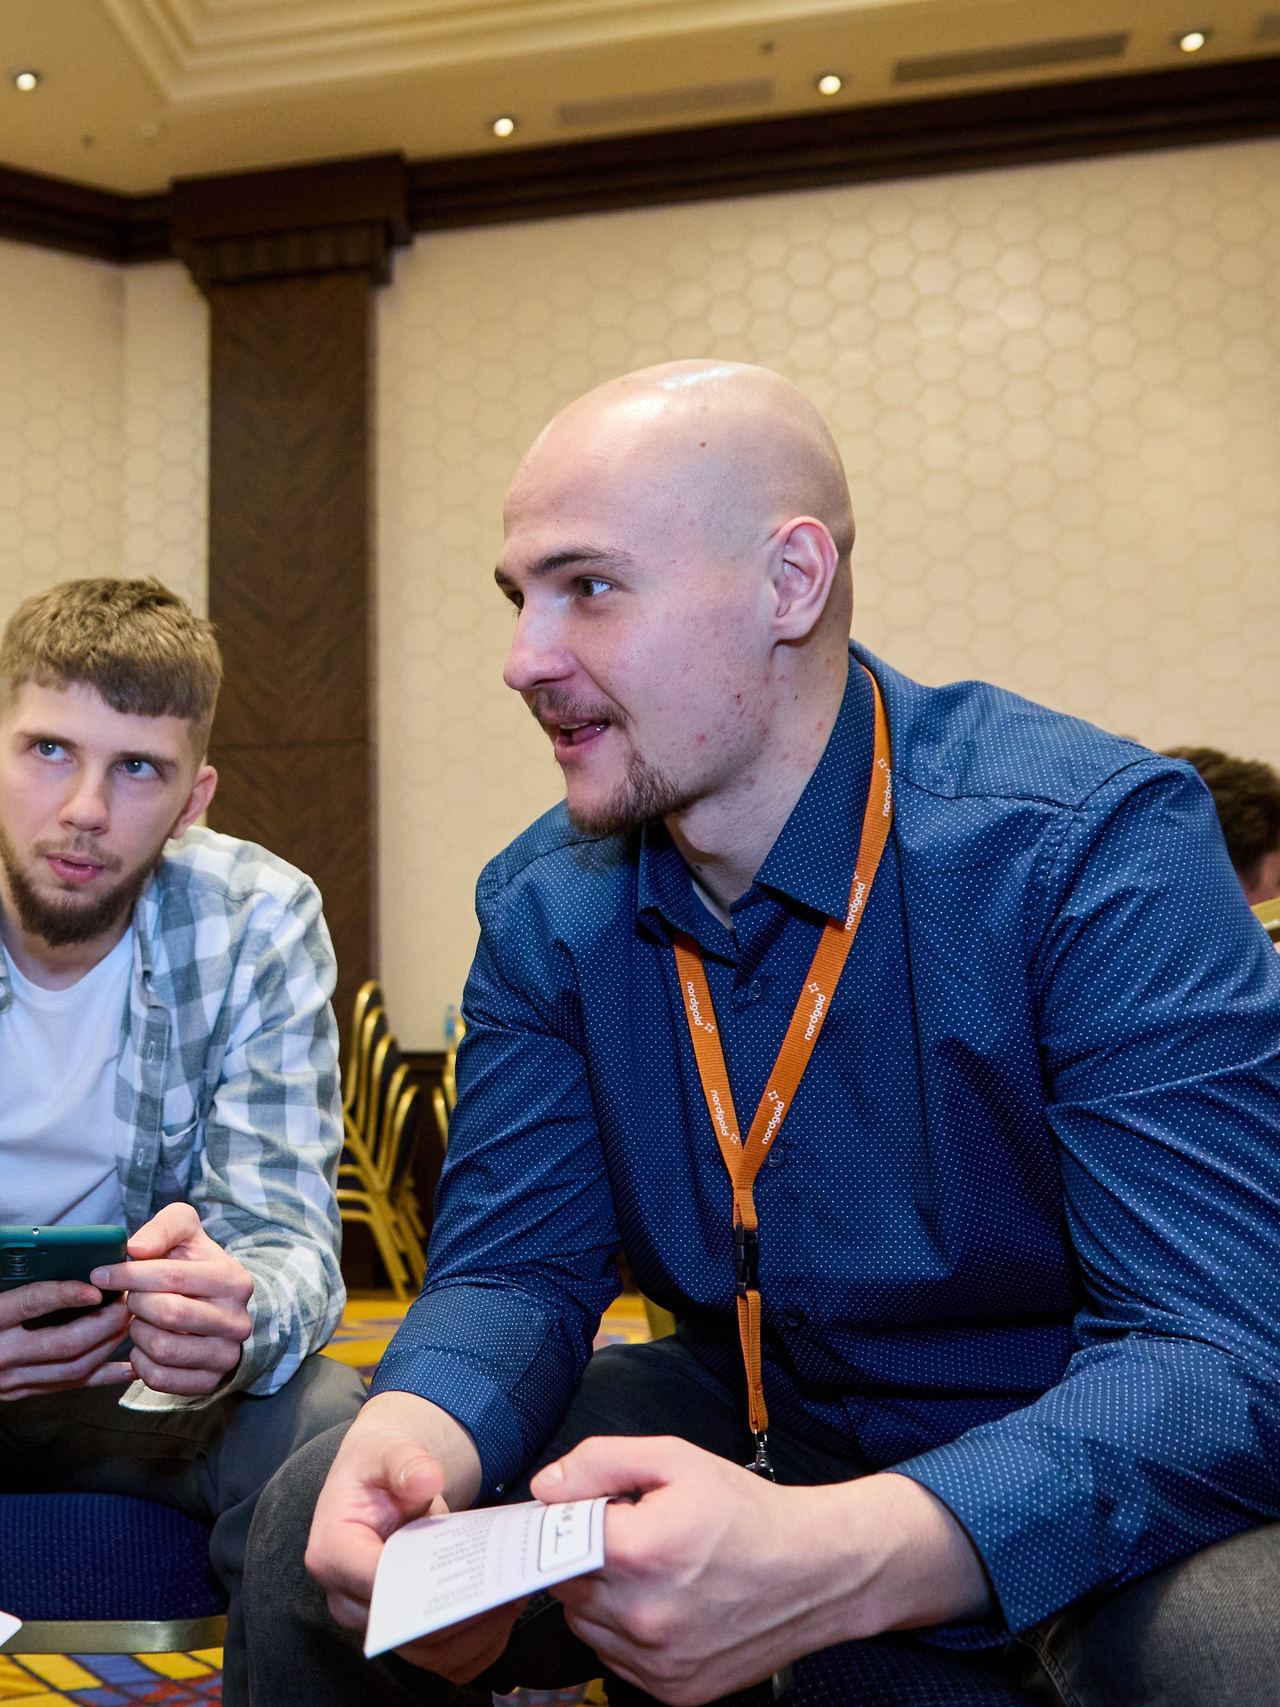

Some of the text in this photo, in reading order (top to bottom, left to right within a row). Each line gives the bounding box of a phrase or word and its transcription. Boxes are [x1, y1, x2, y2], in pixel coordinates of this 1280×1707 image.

[844, 881, 866, 931] nordgold
[686, 981, 704, 1026] nordgold
[804, 993, 826, 1041] nordgold
[710, 1089, 730, 1137] nordgold
[761, 1100, 785, 1145] nordgold
